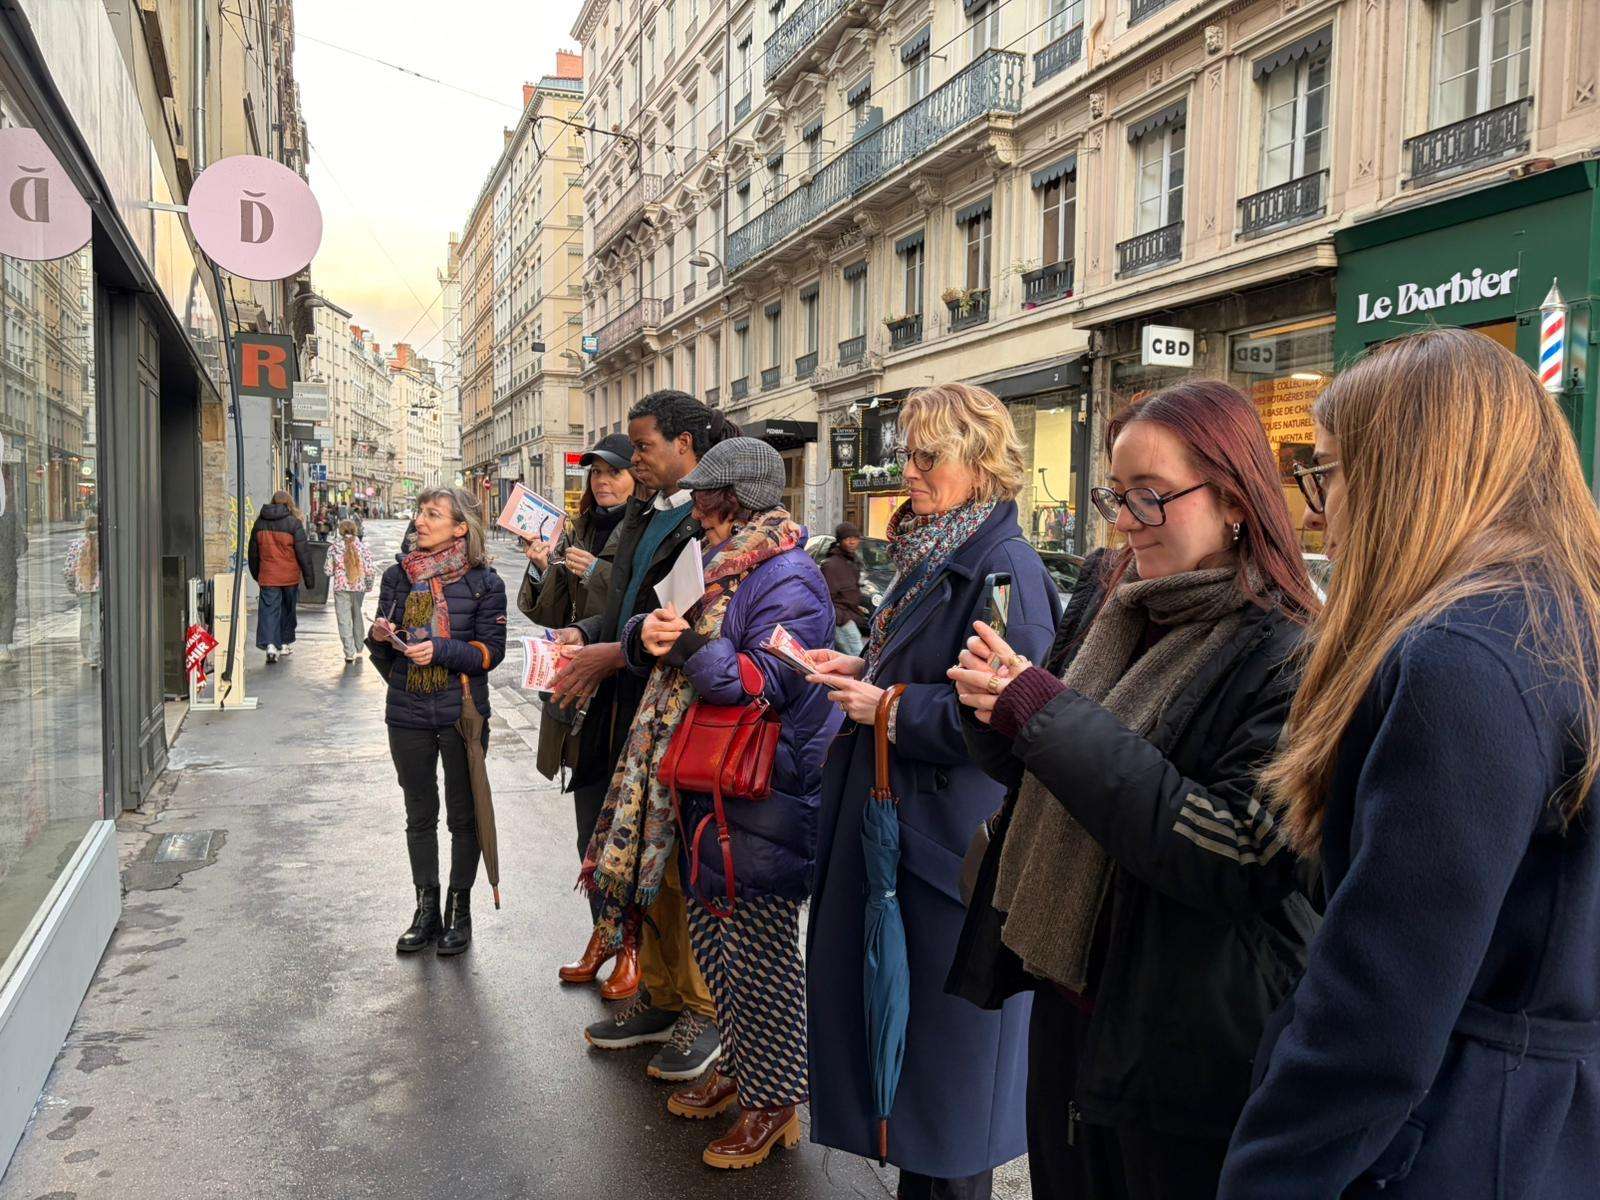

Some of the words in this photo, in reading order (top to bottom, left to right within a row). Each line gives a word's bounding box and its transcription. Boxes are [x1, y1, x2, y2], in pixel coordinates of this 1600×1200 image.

[1357, 293, 1393, 324] Le
[1396, 267, 1519, 316] Barbier
[1152, 338, 1190, 356] CBD
[241, 343, 288, 390] R
[1267, 406, 1283, 418] BASE
[1284, 406, 1293, 415] DE
